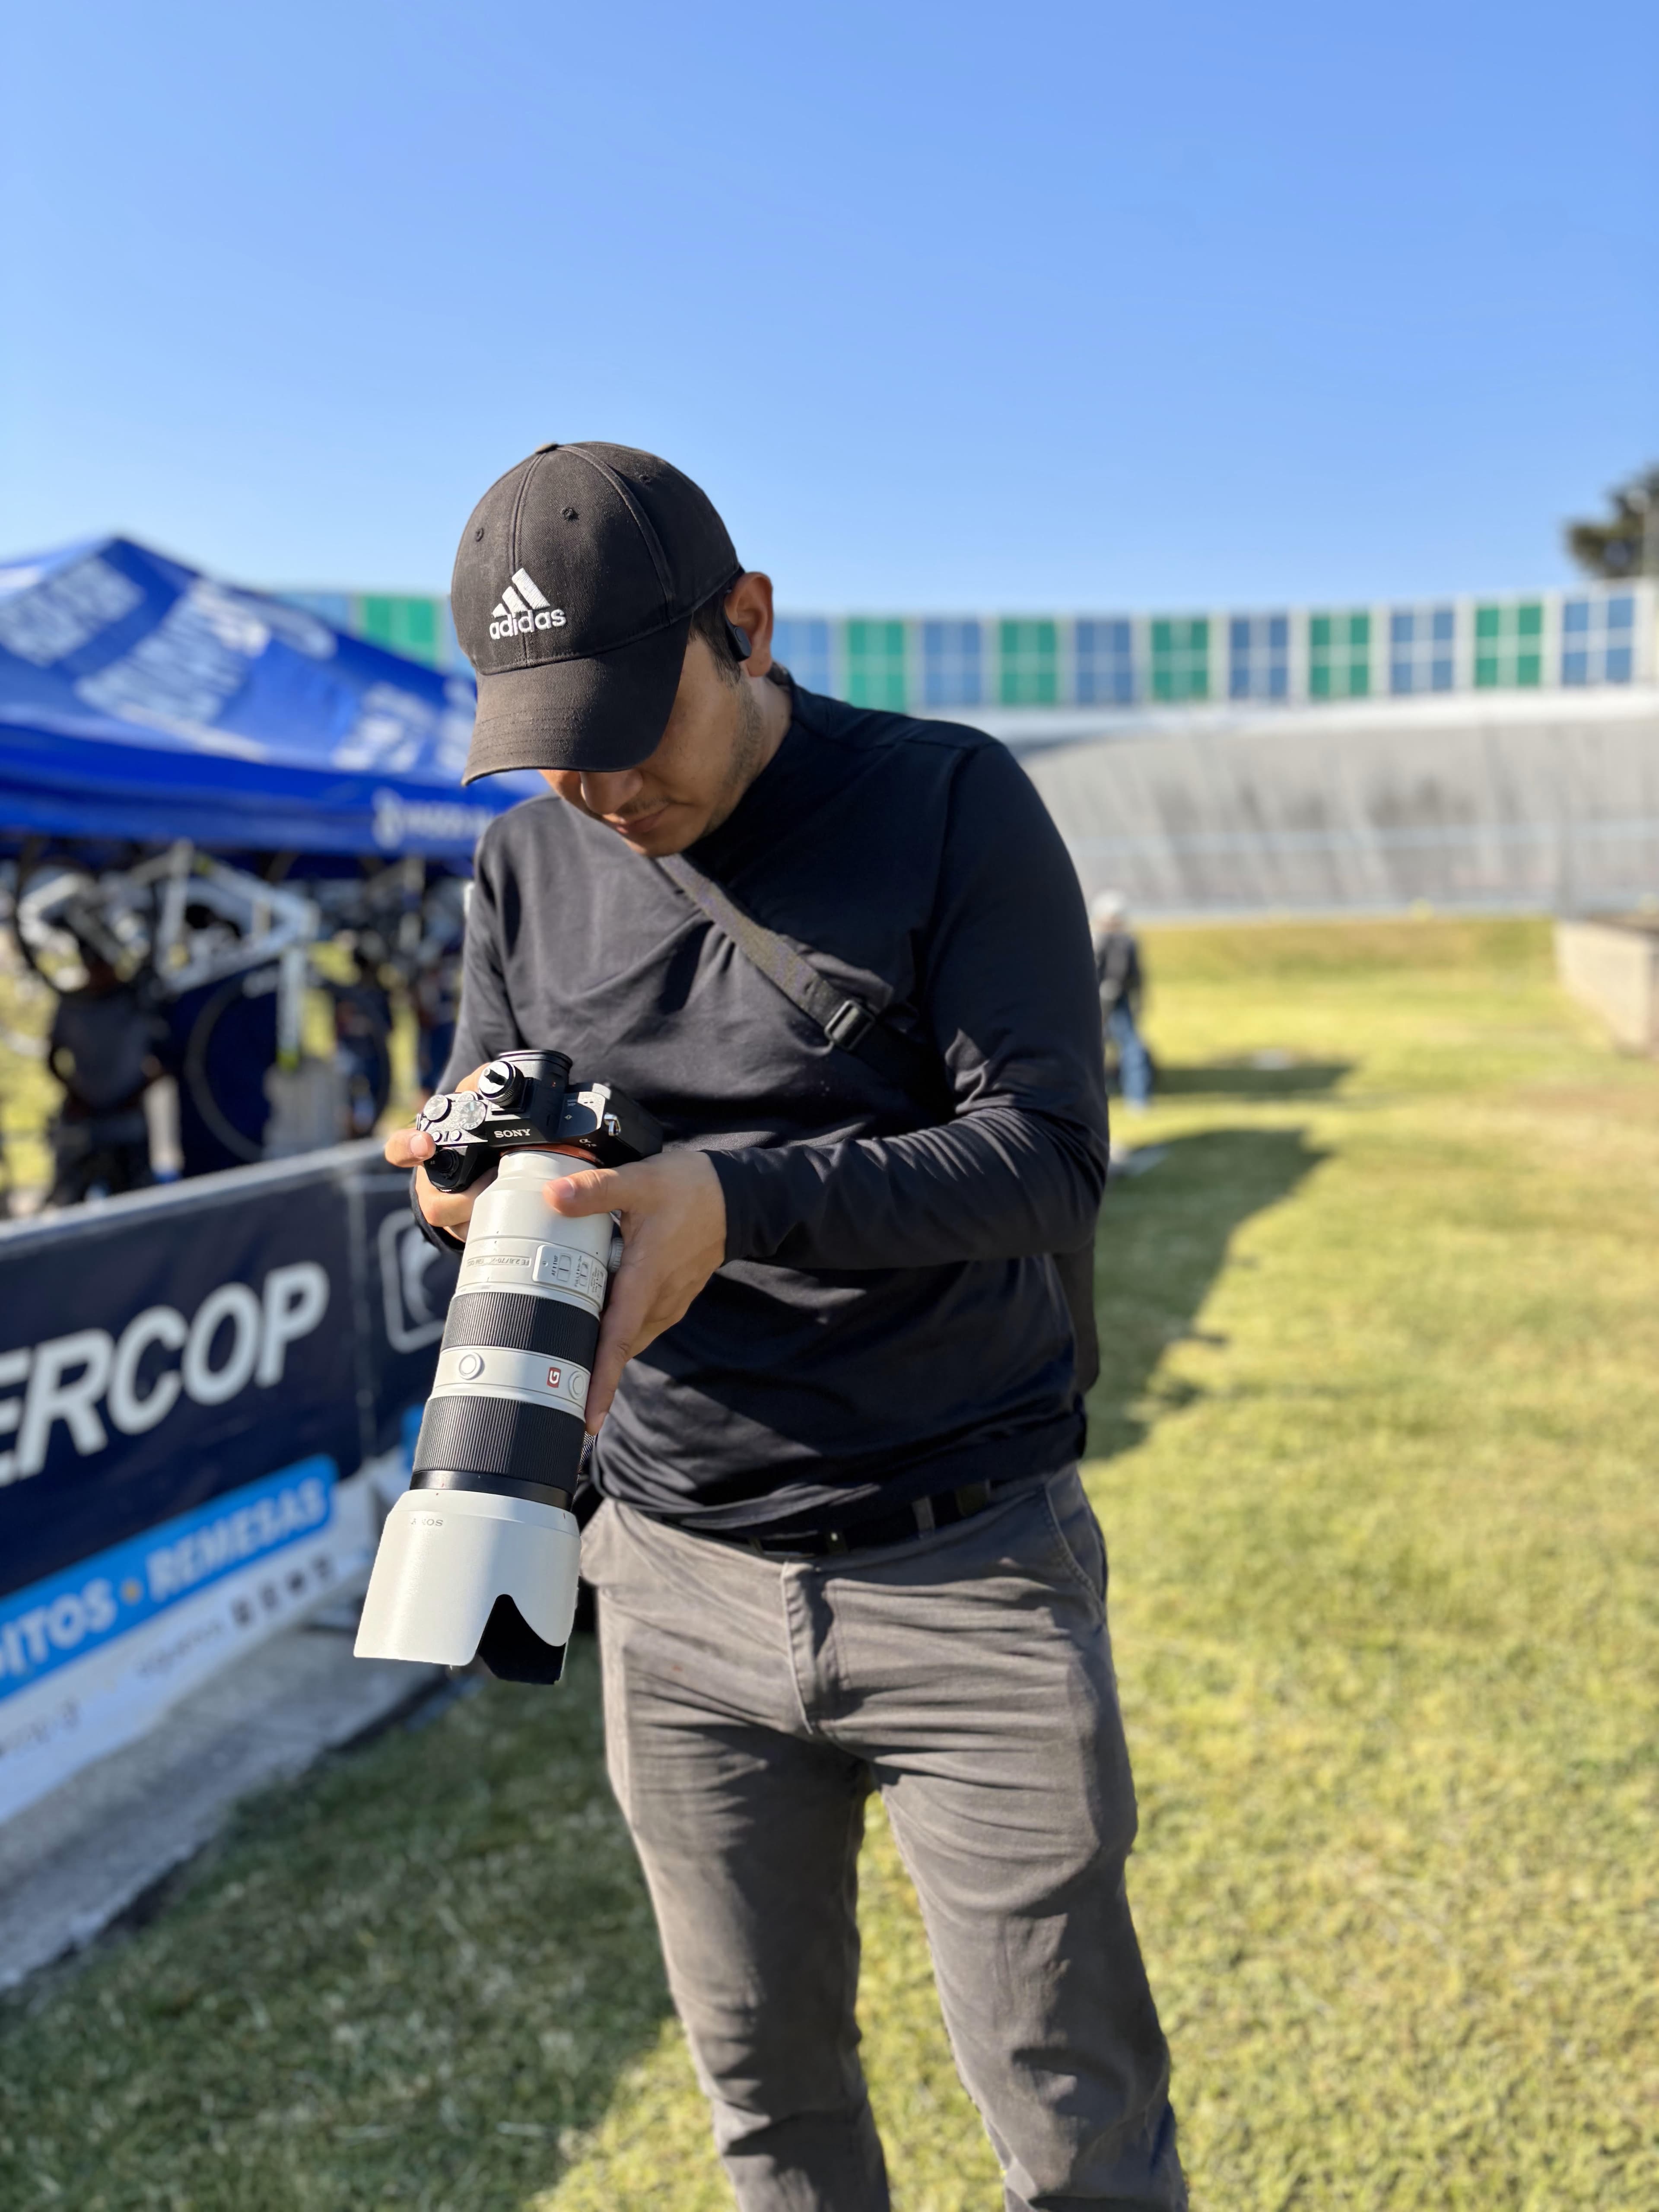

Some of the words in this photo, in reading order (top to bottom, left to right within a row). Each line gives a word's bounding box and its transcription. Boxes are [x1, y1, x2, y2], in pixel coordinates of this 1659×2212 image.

[489, 609, 566, 639] adidas
[494, 1128, 531, 1138] SONY
[0, 1577, 118, 1678] ITOS
